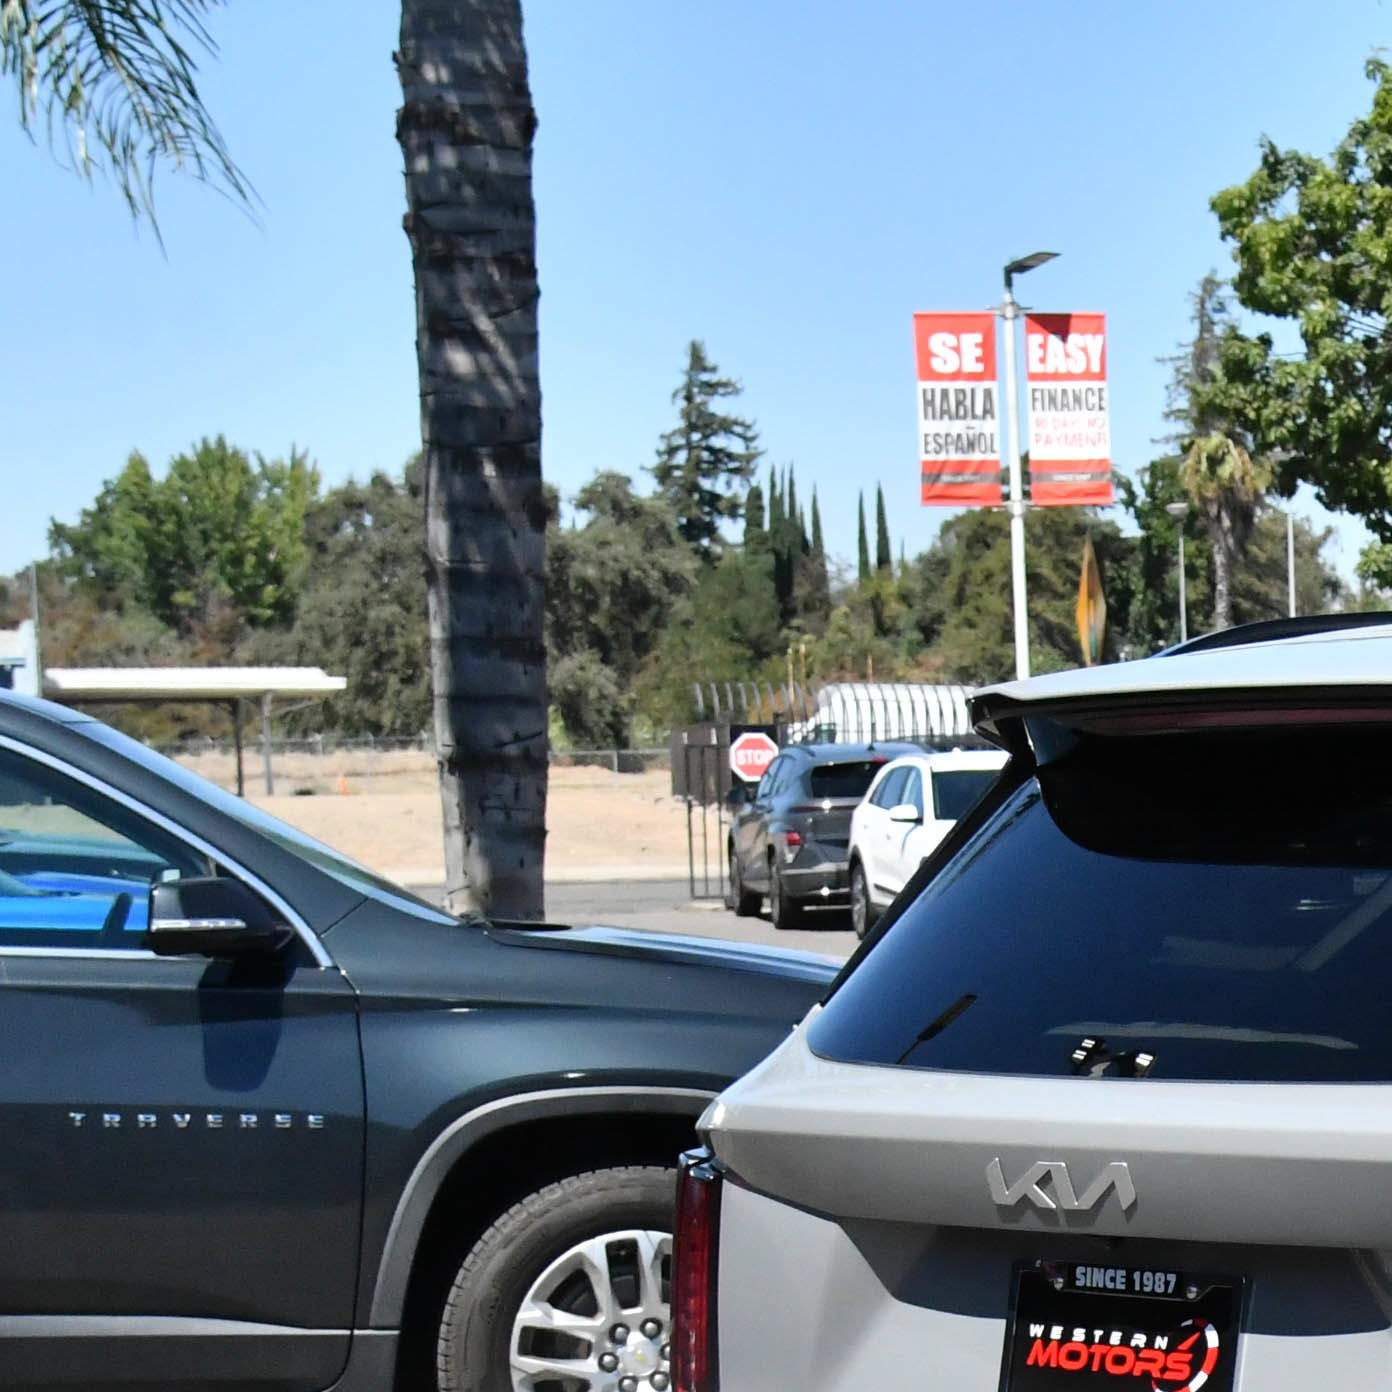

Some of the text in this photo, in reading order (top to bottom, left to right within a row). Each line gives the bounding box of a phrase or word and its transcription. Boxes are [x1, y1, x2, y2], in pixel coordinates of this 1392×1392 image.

[928, 332, 985, 374] SE
[1028, 333, 1105, 374] EASY
[922, 387, 996, 421] HABLA
[1031, 387, 1106, 412] FINANCE
[924, 425, 997, 455] ESPAÑOL
[735, 749, 776, 766] STOP
[68, 1111, 325, 1129] TRAVERSE
[1075, 1265, 1177, 1293] SINCE 1987
[1028, 1323, 1168, 1350] WESTERN
[1026, 1338, 1194, 1381] MOTORS
